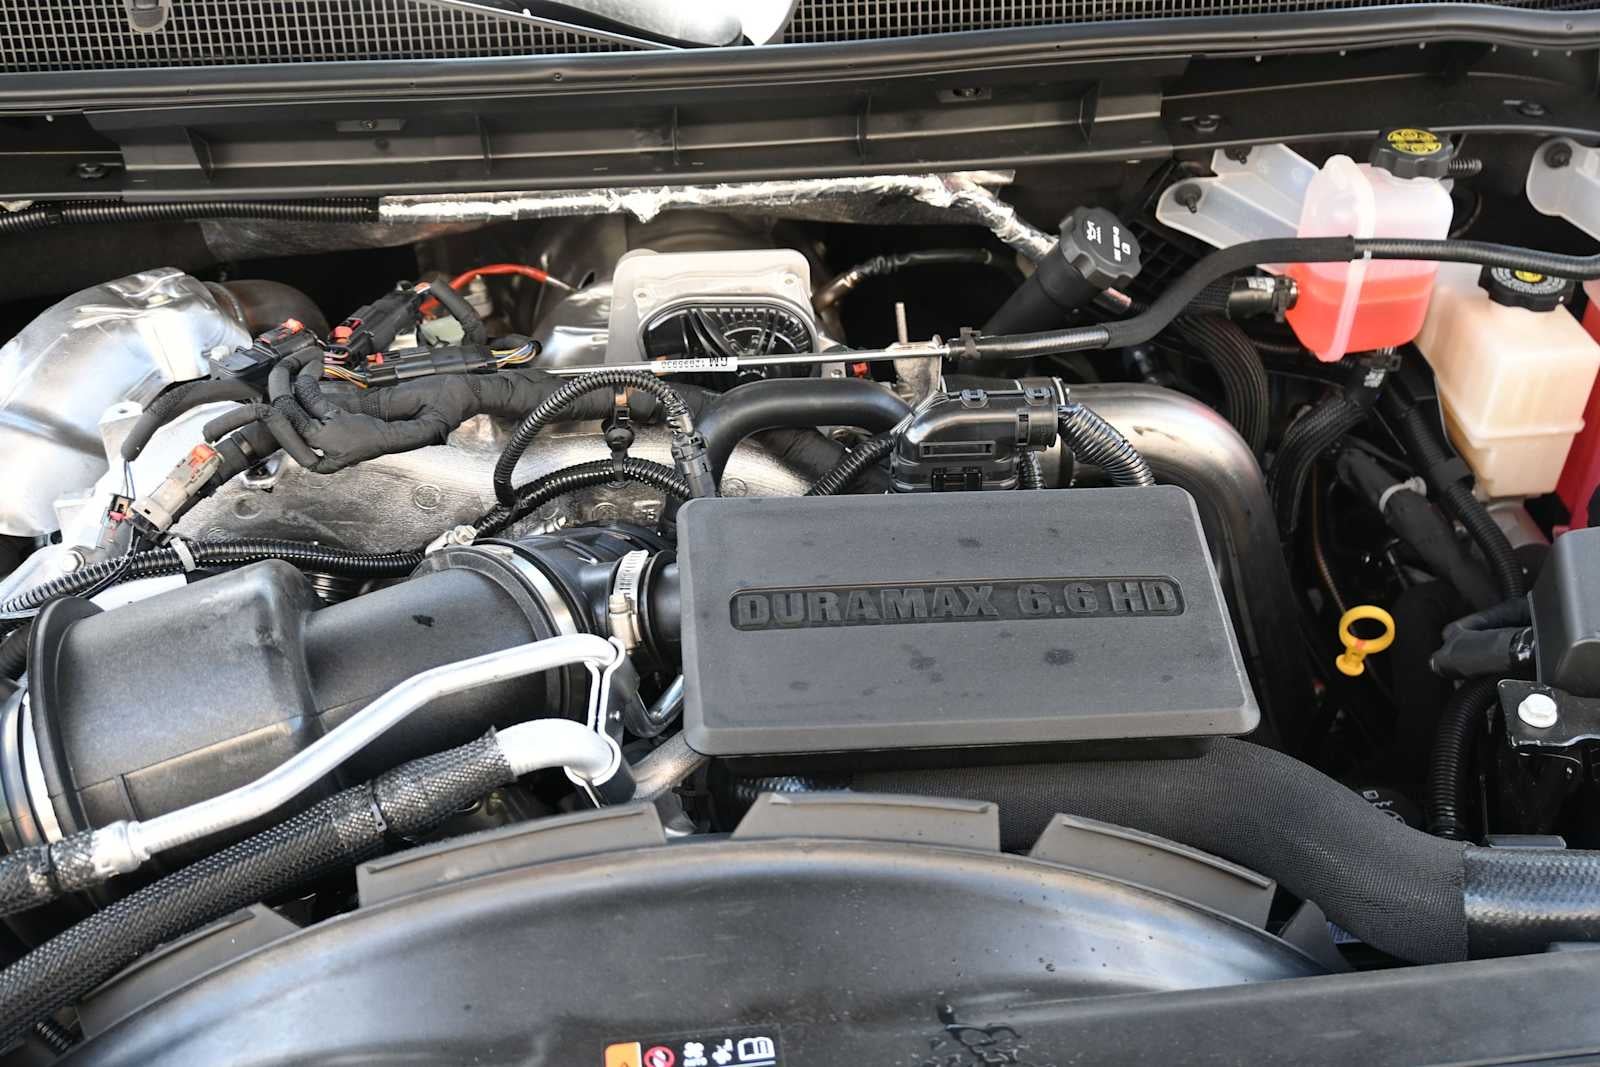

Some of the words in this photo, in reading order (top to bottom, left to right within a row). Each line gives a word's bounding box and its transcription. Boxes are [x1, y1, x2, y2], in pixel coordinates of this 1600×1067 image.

[737, 585, 998, 624] DURAMAX
[1017, 582, 1099, 616] 6.6
[1107, 580, 1181, 613] HD
